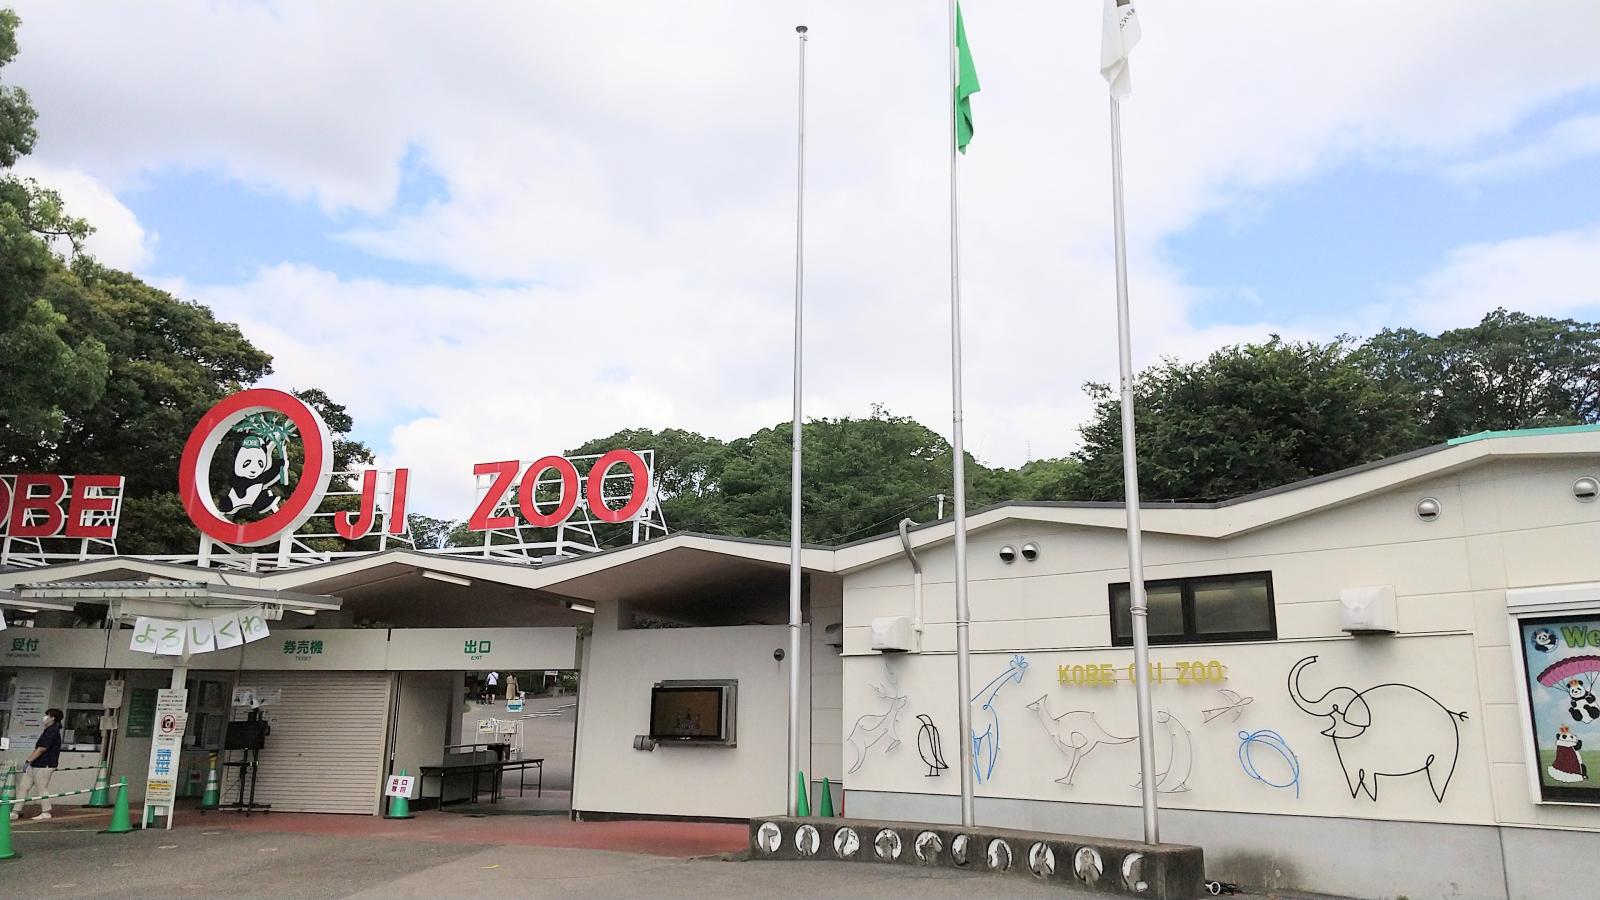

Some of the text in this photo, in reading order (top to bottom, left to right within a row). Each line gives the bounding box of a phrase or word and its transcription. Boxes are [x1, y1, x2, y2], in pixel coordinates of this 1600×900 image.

[243, 439, 259, 447] KOBE
[468, 449, 650, 532] ZOO
[135, 614, 264, 648] よろしくね
[11, 638, 40, 652] 受付
[283, 639, 324, 655] 券売機
[464, 639, 491, 654] 出口
[1058, 663, 1113, 686] KOBE
[1175, 660, 1225, 685] ZOO
[392, 778, 408, 786] 出口
